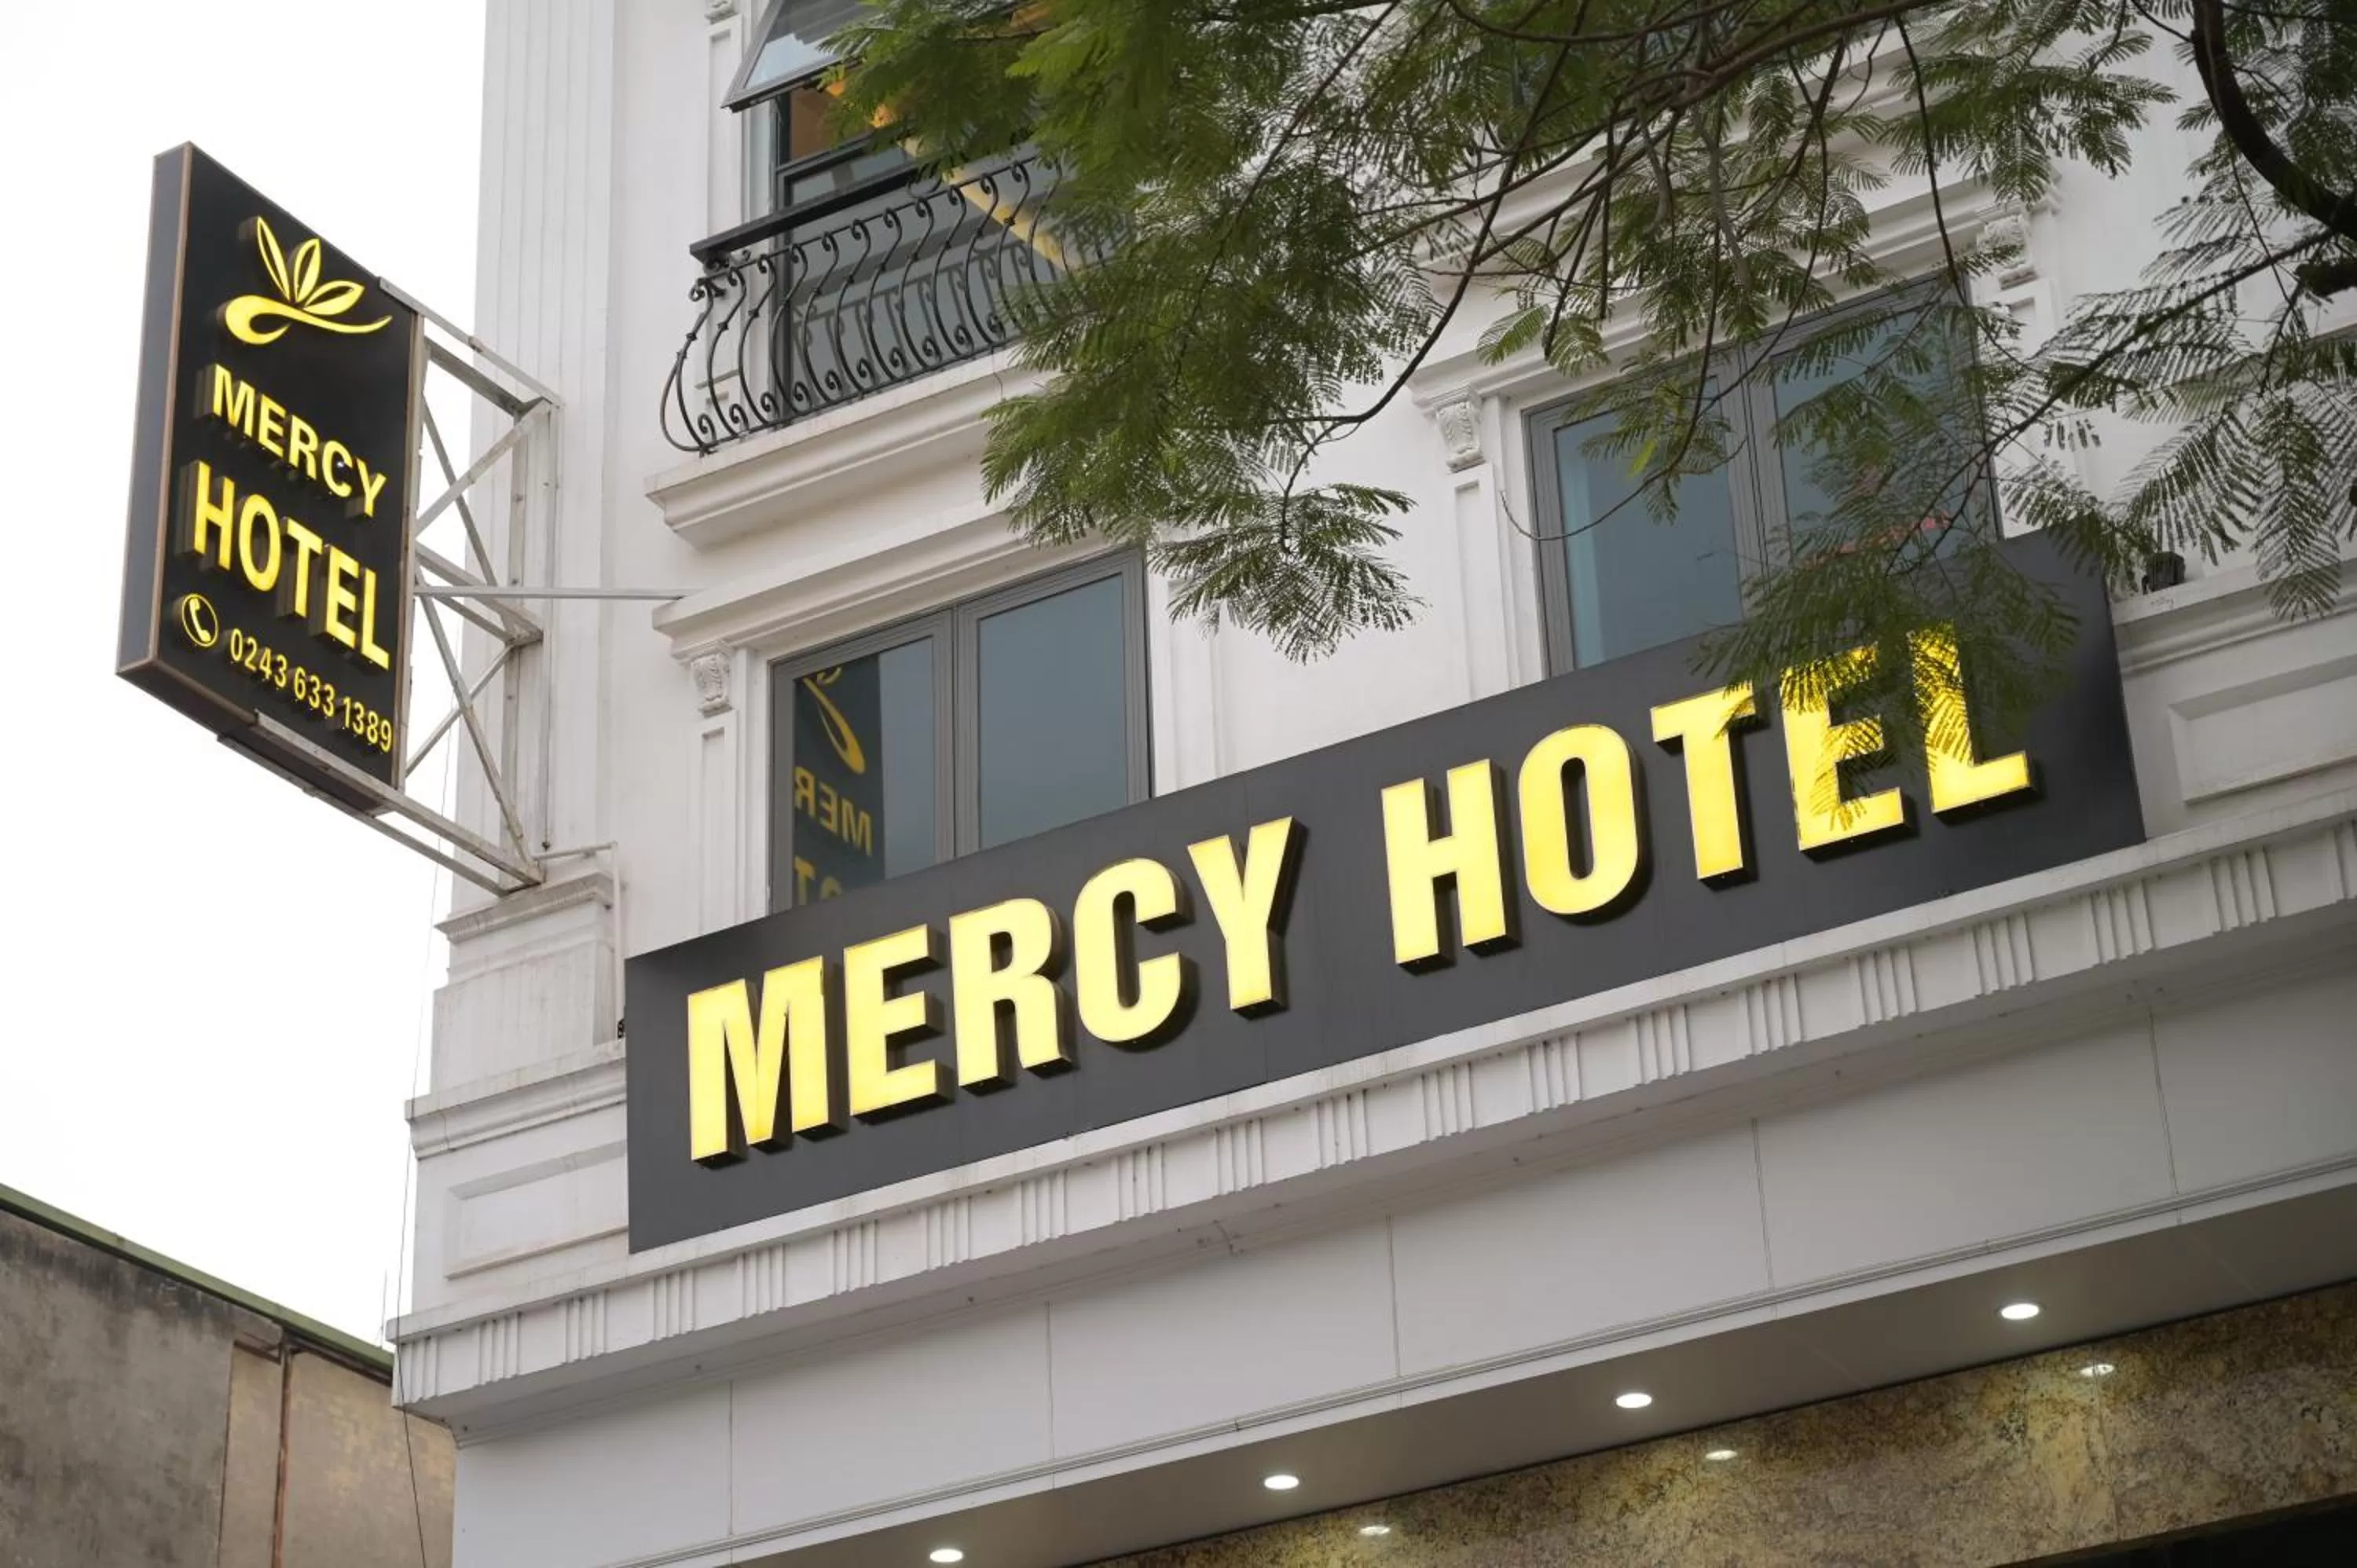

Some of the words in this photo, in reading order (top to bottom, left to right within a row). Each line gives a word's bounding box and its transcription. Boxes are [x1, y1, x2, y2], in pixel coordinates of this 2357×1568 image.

[212, 363, 387, 518] MERCY
[193, 460, 390, 671] HOTEL
[229, 628, 288, 688] 0243
[293, 666, 335, 718] 633
[342, 696, 393, 753] 1389
[687, 815, 1293, 1161] MERCY
[1381, 621, 2030, 965] HOTEL
